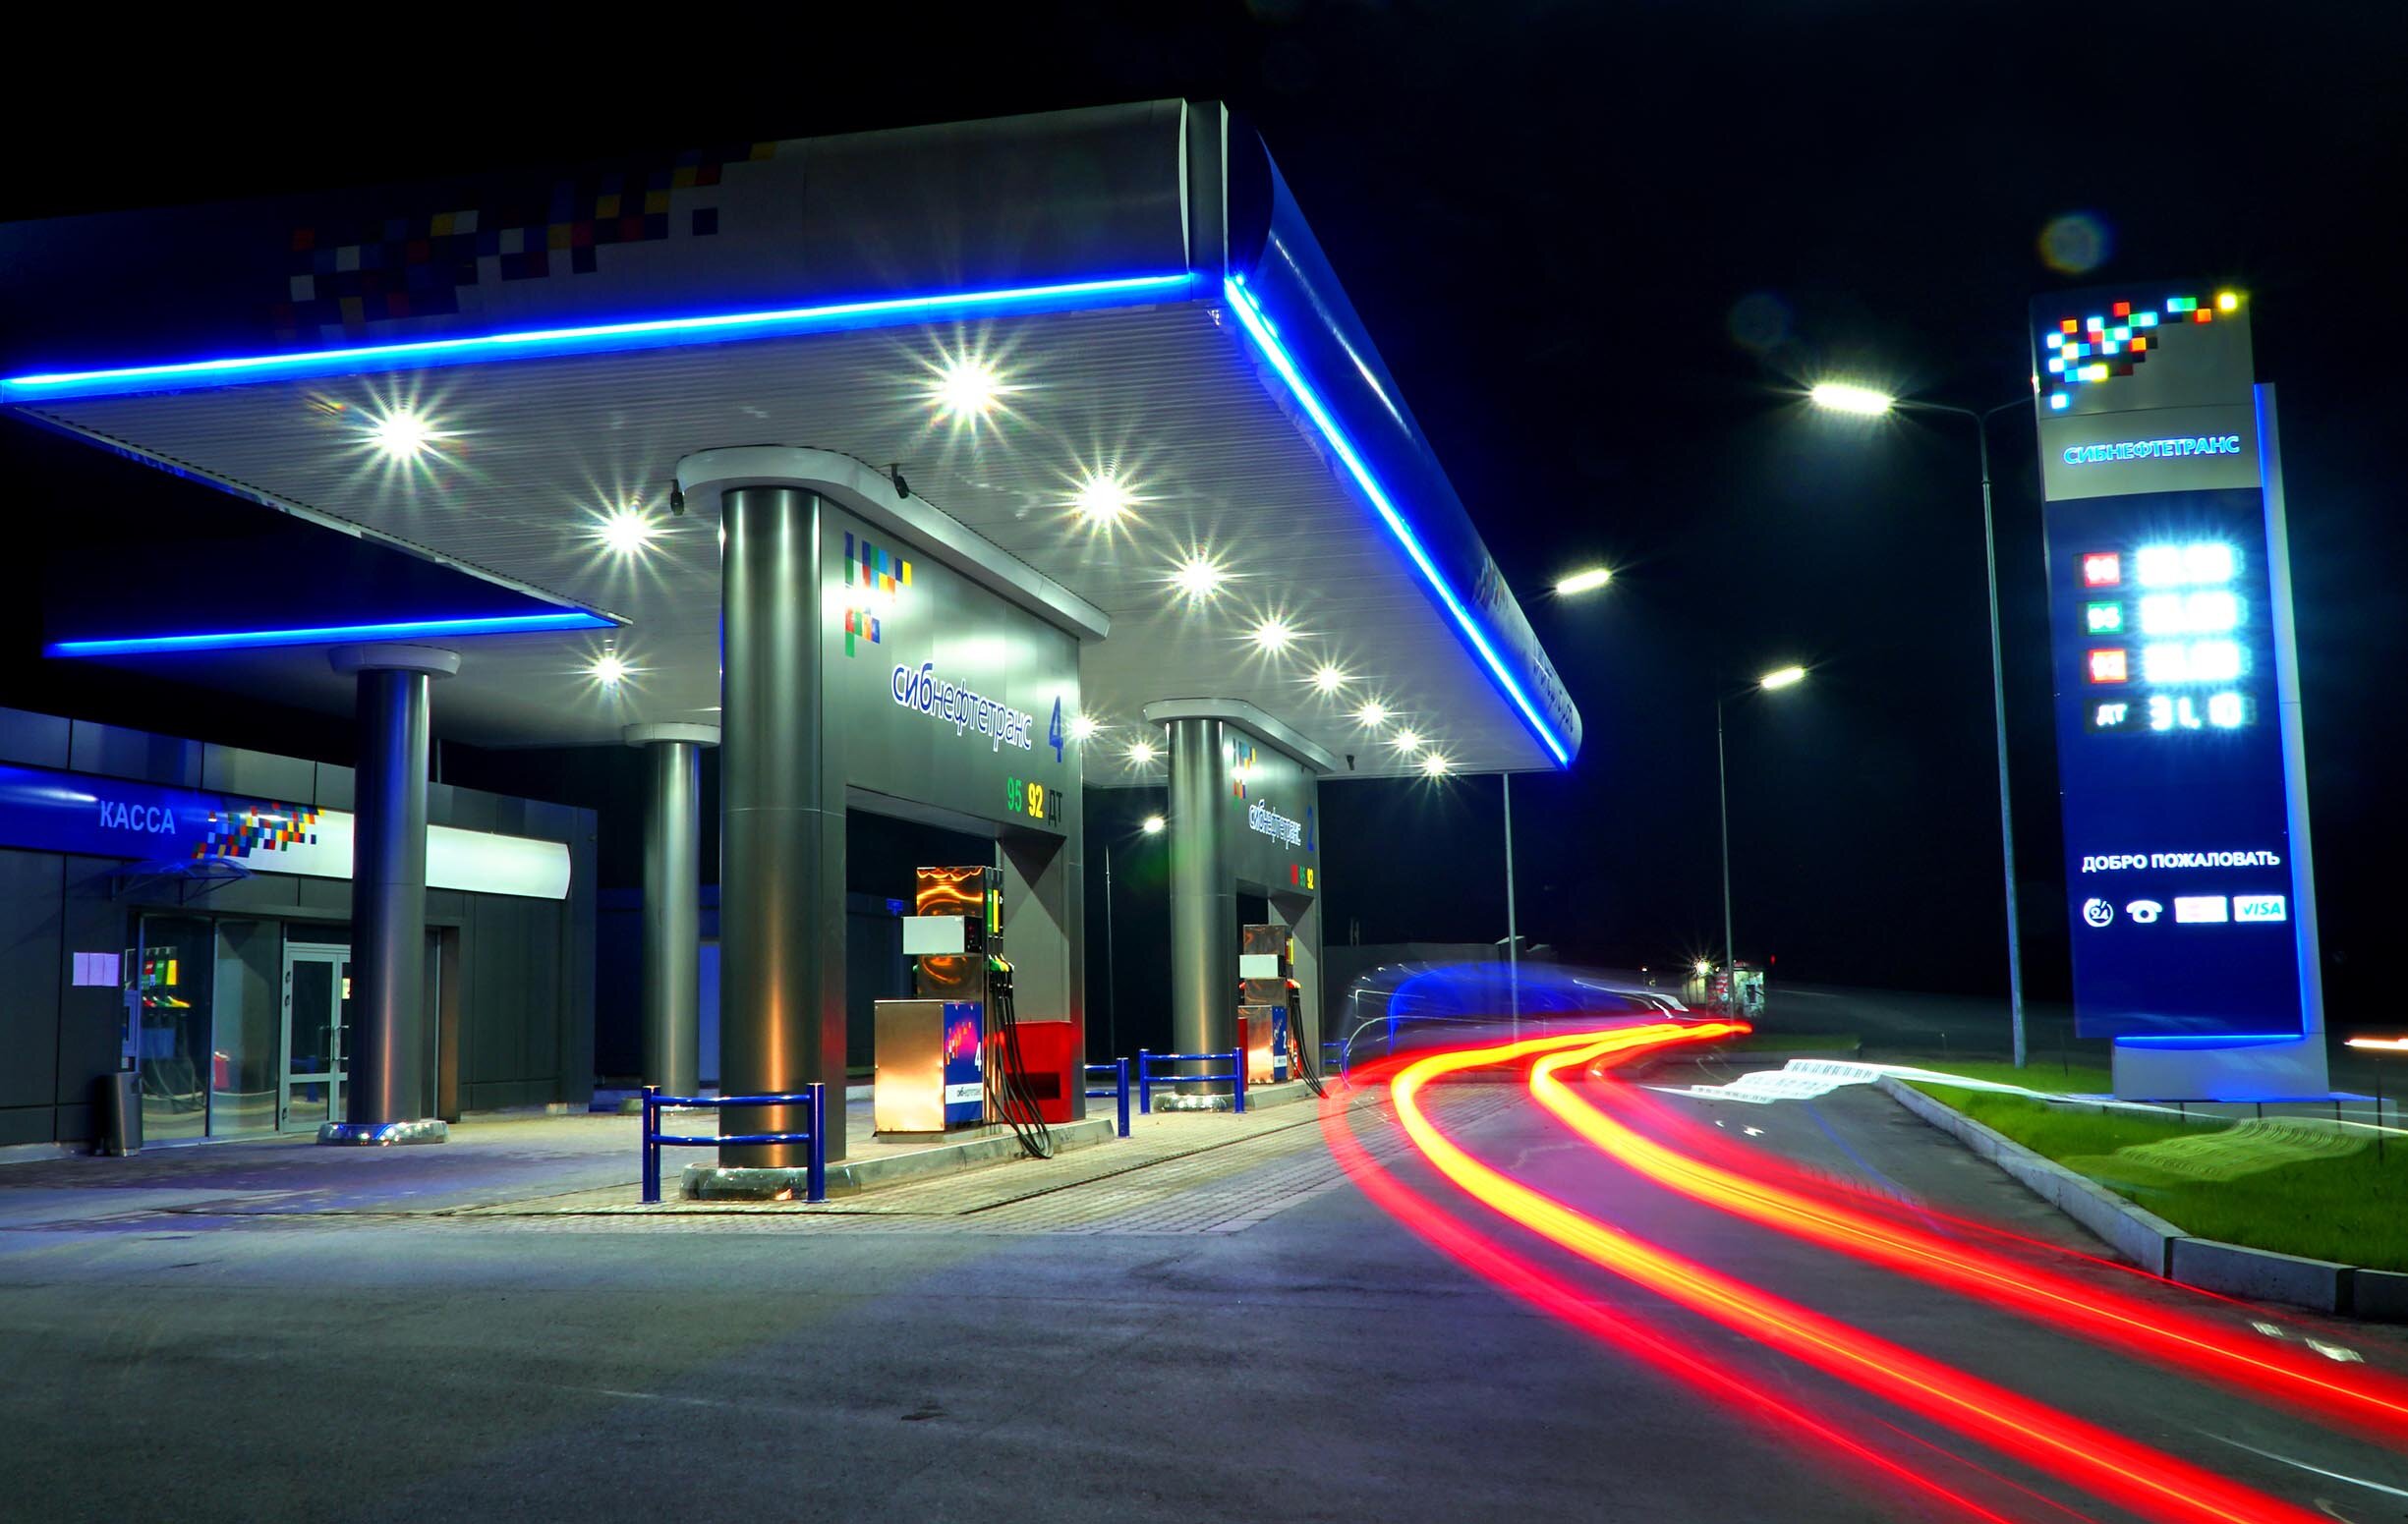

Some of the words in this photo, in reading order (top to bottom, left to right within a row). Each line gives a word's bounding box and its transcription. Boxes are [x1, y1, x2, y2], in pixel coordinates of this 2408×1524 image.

[2063, 435, 2241, 465] СИБНЕФТЕТРАНС
[891, 659, 1033, 752] сибнефтетранс
[1048, 695, 1064, 763] 4
[100, 800, 176, 834] КАССА
[1006, 775, 1023, 814] 95
[1028, 781, 1044, 818] 92
[1047, 788, 1063, 827] ДТ
[2082, 853, 2149, 874] ДОБРО
[2151, 851, 2281, 870] ПОЖАЛОВАТЬ
[2241, 901, 2282, 916] VISA
[974, 1042, 983, 1072] 4
